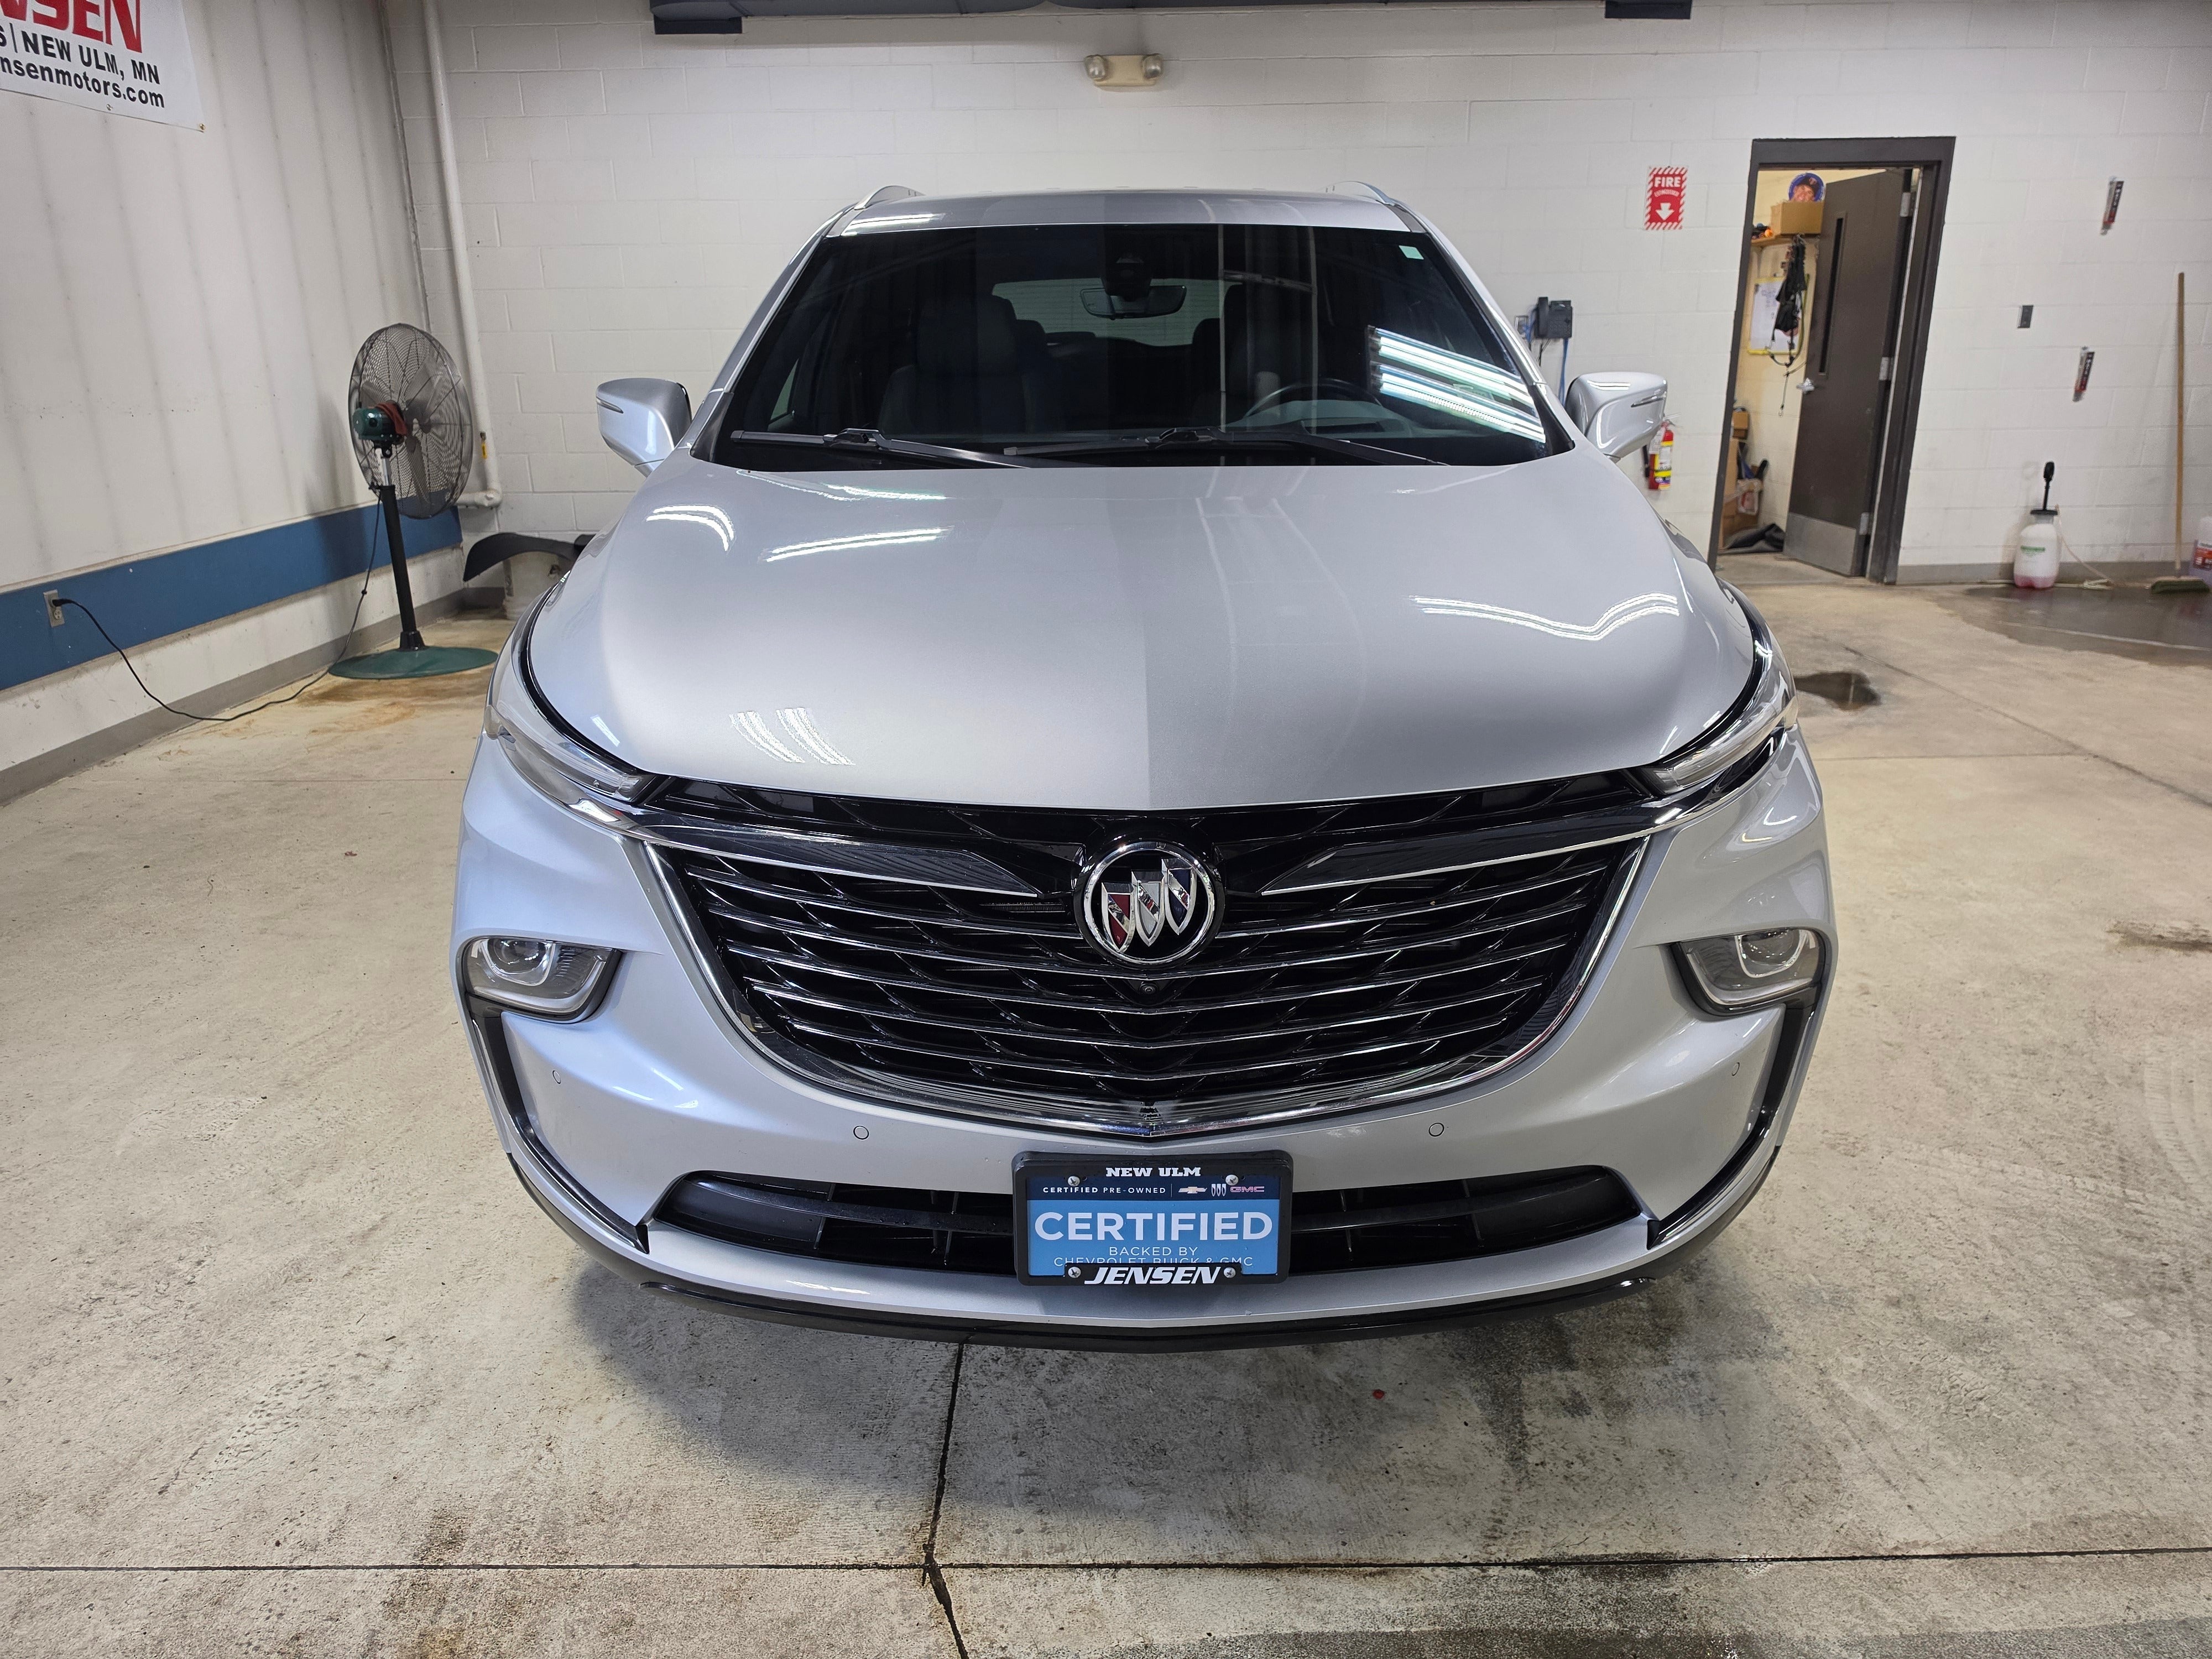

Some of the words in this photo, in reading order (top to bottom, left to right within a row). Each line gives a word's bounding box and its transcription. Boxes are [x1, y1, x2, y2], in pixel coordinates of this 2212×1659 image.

[21, 30, 71, 62] NEW
[79, 44, 124, 81] ULM,
[131, 59, 160, 85] MN
[0, 56, 165, 108] nsenmotors.com
[1654, 176, 1681, 187] FIRE
[1106, 1167, 1152, 1177] NEW
[1159, 1167, 1201, 1177] ULM
[1035, 1212, 1272, 1240] CERTIFIED
[1109, 1246, 1171, 1256] BACKED
[1179, 1246, 1198, 1256] BY
[1220, 1257, 1253, 1266] GMC
[1084, 1266, 1221, 1285] JENSEN
